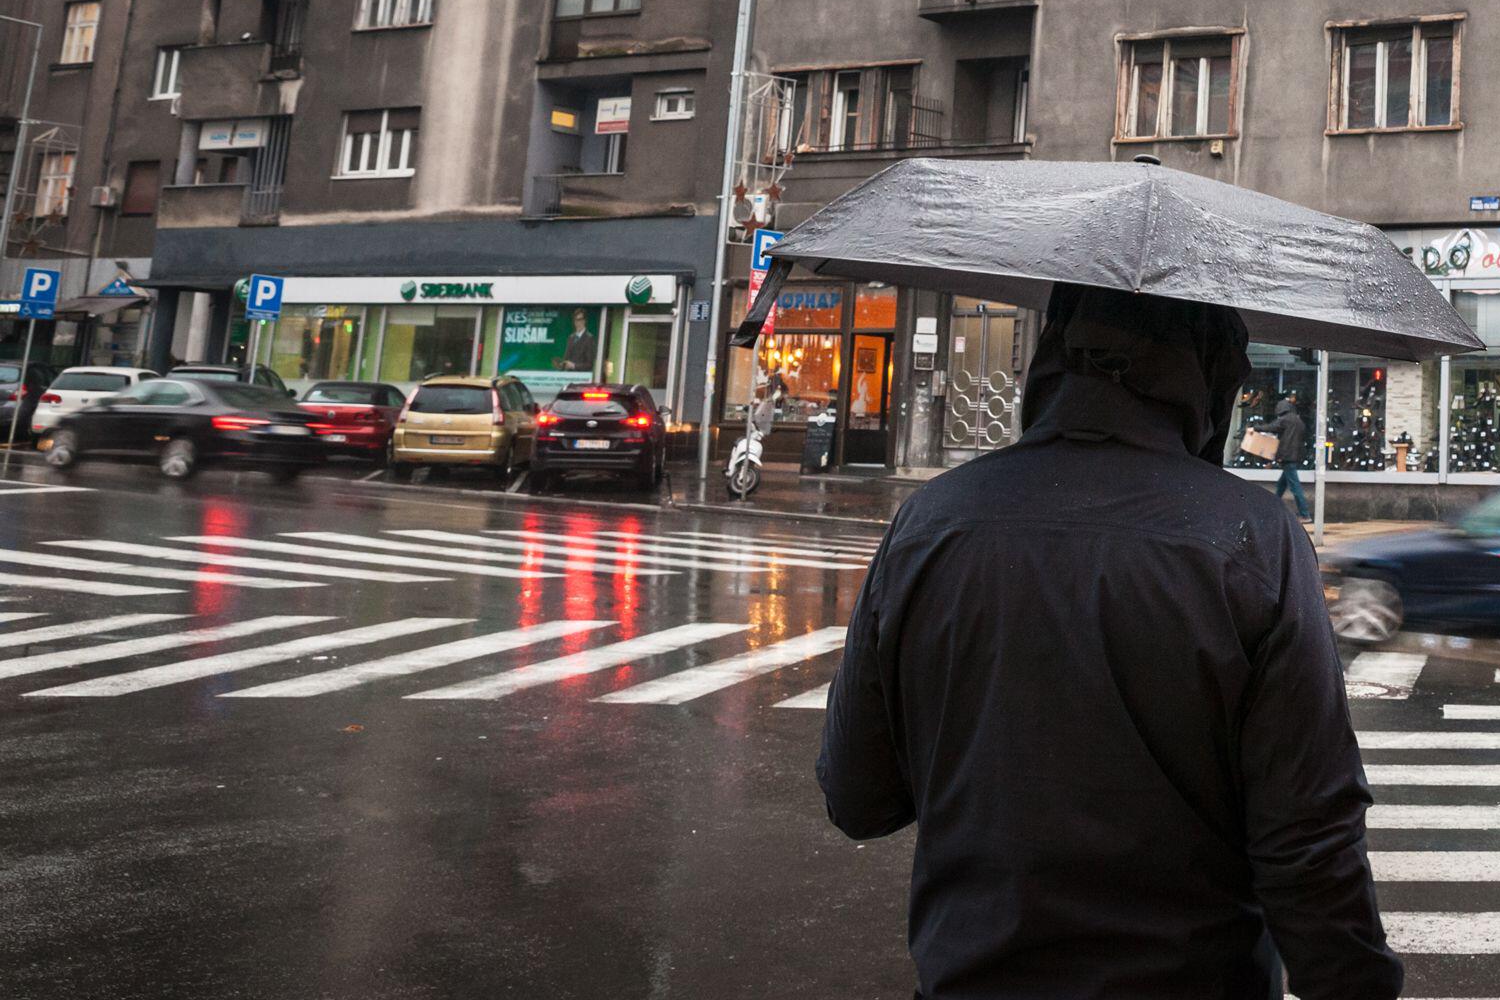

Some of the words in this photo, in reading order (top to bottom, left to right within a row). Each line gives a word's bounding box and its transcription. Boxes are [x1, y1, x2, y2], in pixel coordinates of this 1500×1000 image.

[29, 272, 52, 298] P
[255, 279, 276, 307] P
[420, 283, 494, 299] SBERBANK
